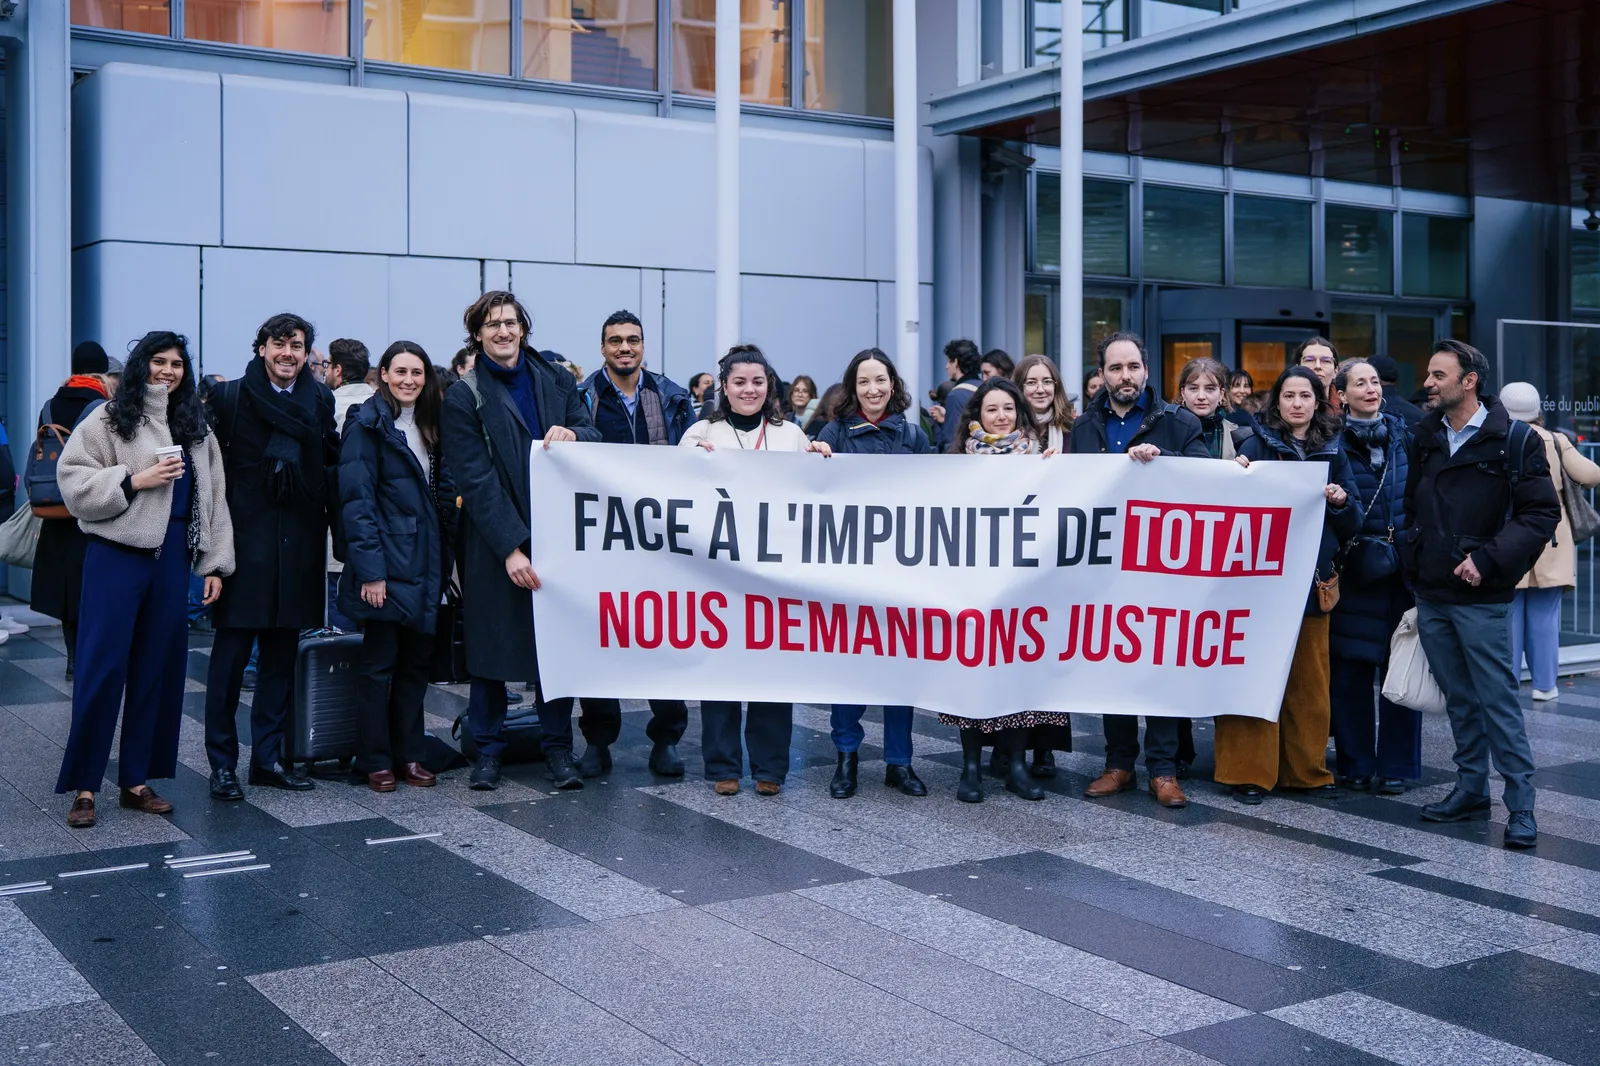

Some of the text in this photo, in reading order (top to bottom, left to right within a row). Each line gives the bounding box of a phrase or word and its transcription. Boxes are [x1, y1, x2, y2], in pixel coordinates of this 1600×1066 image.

[1558, 395, 1572, 411] du
[1574, 395, 1600, 416] publi
[574, 488, 1280, 572] FACE À L'IMPUNITÉ DE TOTAL
[599, 590, 1250, 668] NOUS DEMANDONS JUSTICE
